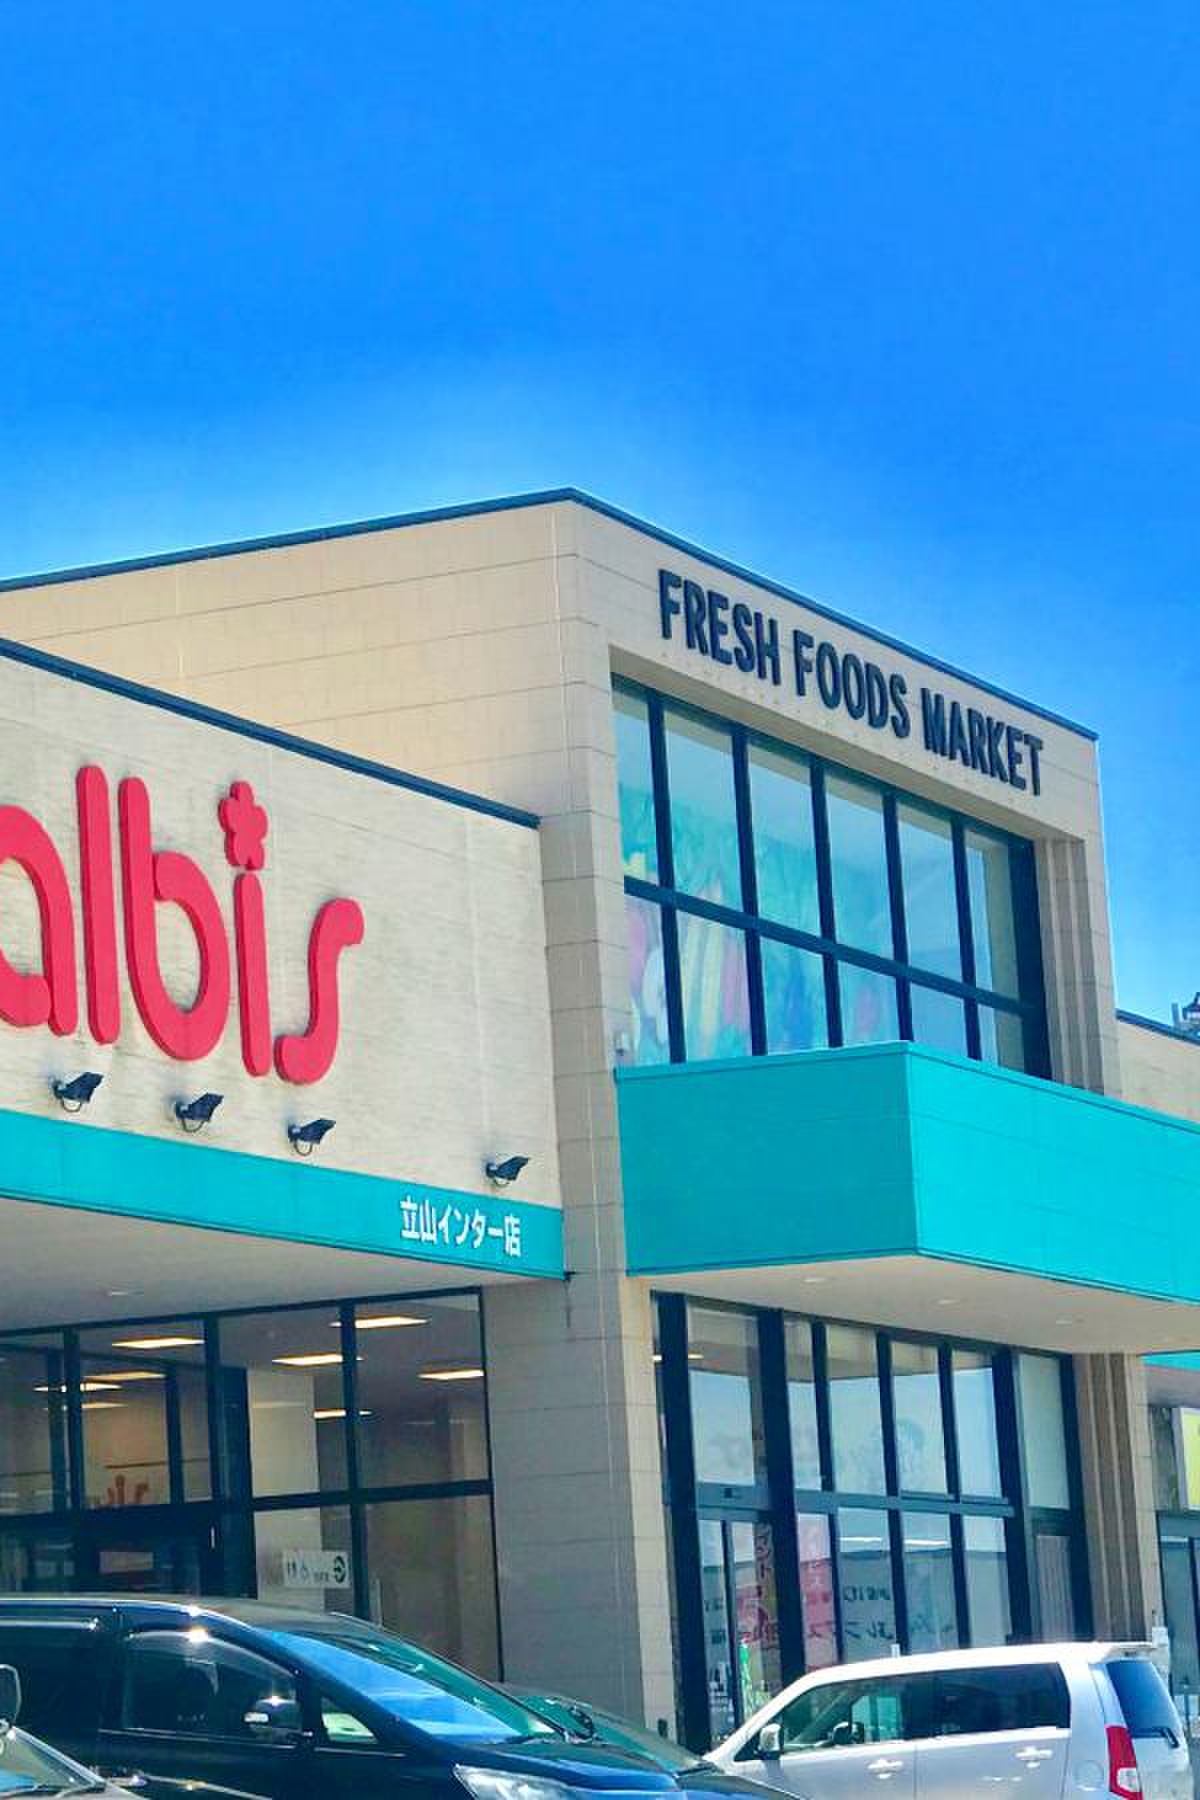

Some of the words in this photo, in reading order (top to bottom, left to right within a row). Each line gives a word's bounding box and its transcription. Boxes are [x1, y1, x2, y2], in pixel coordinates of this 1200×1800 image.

[658, 569, 781, 686] FRESH
[793, 629, 911, 739] FOODS
[920, 688, 1043, 797] MARKET
[400, 1195, 522, 1257] 立山インター店
